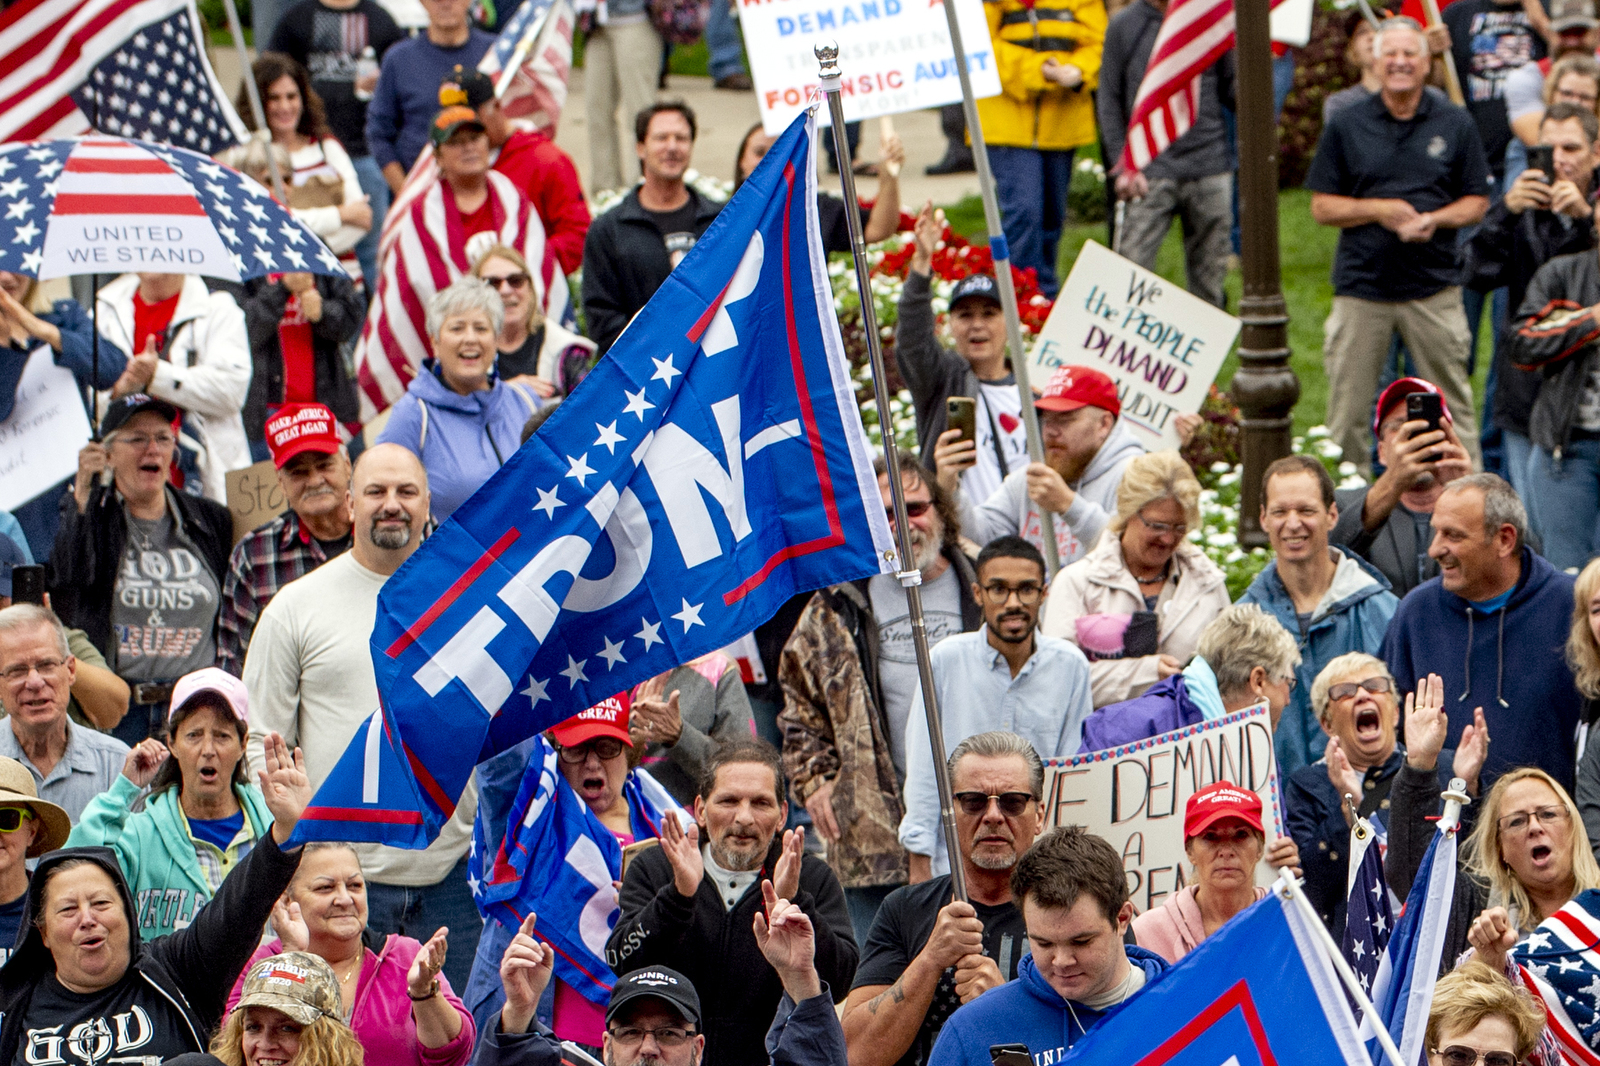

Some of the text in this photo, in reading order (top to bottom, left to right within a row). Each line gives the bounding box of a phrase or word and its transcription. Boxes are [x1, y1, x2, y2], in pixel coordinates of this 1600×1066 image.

[776, 0, 904, 36] DEMAND
[765, 70, 904, 110] FORNSIC
[83, 226, 183, 242] UNITED
[67, 247, 205, 264] WE STAND
[1126, 269, 1163, 307] We
[1083, 285, 1206, 368] the PEOPLE
[267, 408, 331, 436] MAKE AMERICA
[274, 421, 328, 447] GREAT AGAIN
[120, 586, 195, 610] GUNS
[147, 608, 166, 628] &
[577, 708, 618, 722] GREAT
[1110, 722, 1273, 825] DEMAND
[1197, 788, 1254, 804] KEEP AMERICA
[1121, 831, 1145, 867] A
[263, 961, 309, 980] Trump
[267, 977, 292, 987] 2020
